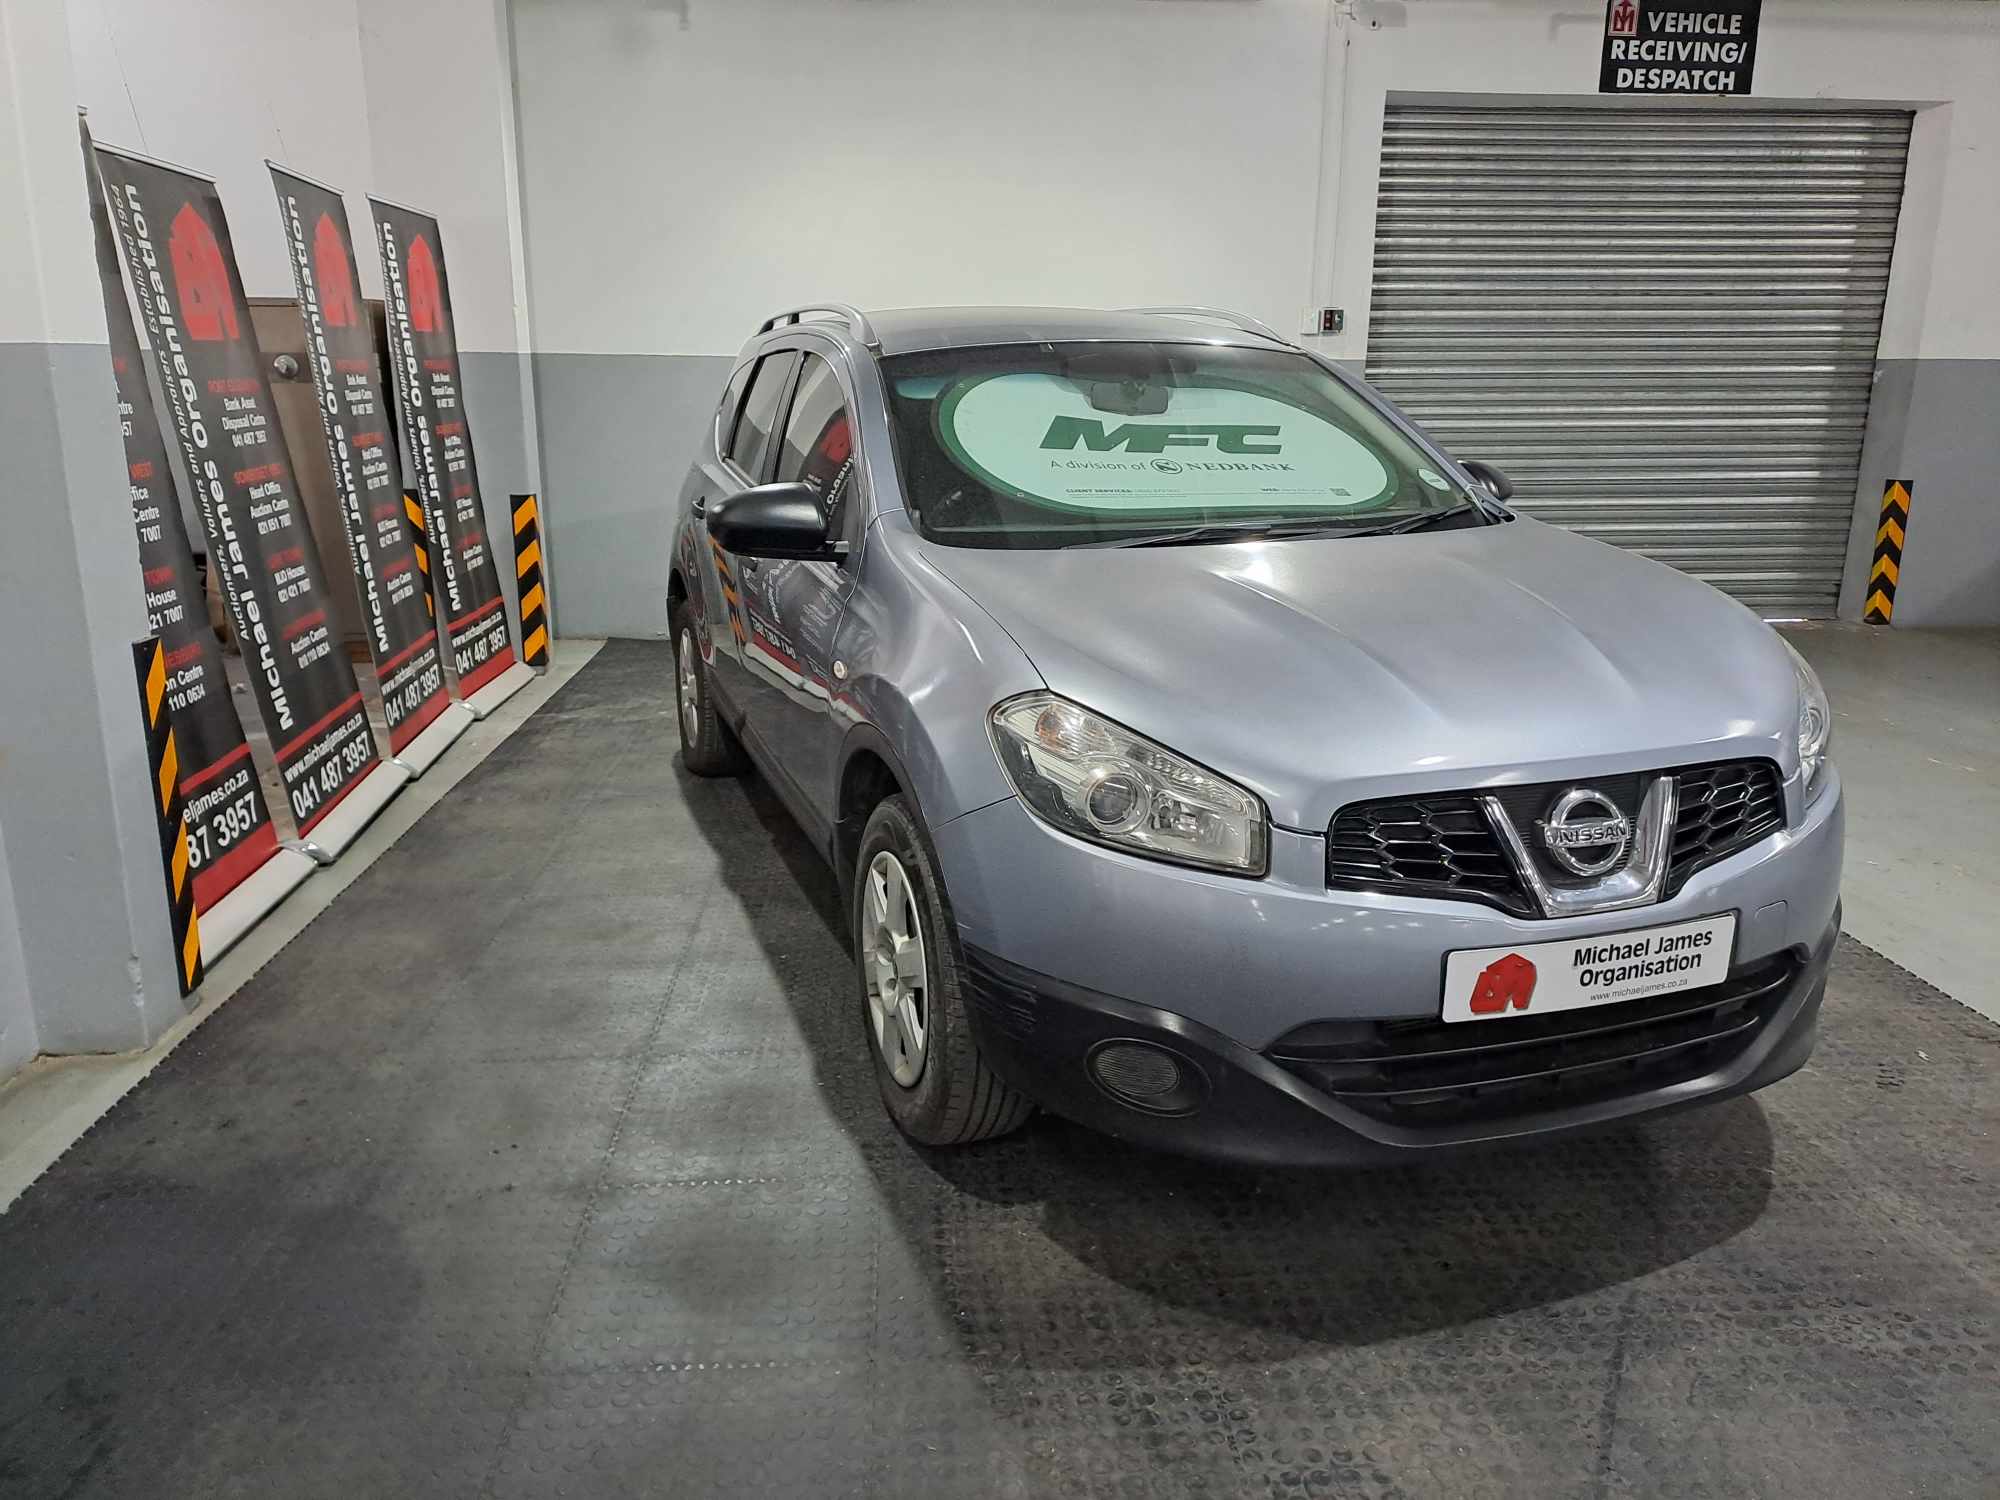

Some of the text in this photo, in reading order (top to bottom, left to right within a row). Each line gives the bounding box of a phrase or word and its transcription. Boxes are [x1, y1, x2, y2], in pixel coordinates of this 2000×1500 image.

[1647, 11, 1742, 35] VEHICLE
[1610, 39, 1748, 64] RECEIVING/
[1615, 67, 1736, 91] DESPATCH
[124, 233, 159, 335] Established
[287, 195, 338, 415] Organisation
[125, 184, 208, 449] Organisation
[383, 222, 422, 408] Organisation
[159, 350, 192, 439] Appraisers
[183, 442, 199, 475] and
[417, 415, 441, 503] James
[1039, 415, 1282, 454] MFC
[333, 424, 363, 526] James
[1050, 458, 1296, 471] A division of NEDBANK
[141, 525, 161, 543] 7007
[195, 479, 218, 539] Valuers
[204, 459, 249, 580] James
[433, 509, 462, 611] Michael
[146, 589, 177, 608] House
[164, 605, 184, 624] 7007
[216, 544, 249, 641] Auctioneers,
[355, 533, 389, 653] Michael
[177, 664, 204, 686] Centre
[239, 589, 294, 731] Michael
[455, 625, 506, 675] 041 487 3957
[186, 683, 206, 704] 0634
[384, 663, 441, 728] 041 487 3957
[292, 731, 372, 818] 041 487 3957
[213, 790, 258, 847] 3957
[1560, 824, 1626, 843] NISSAN
[1573, 929, 1713, 967] Michael James
[1578, 951, 1702, 988] Organisation
[1589, 979, 1689, 1001] www.michaeljames.co.za
